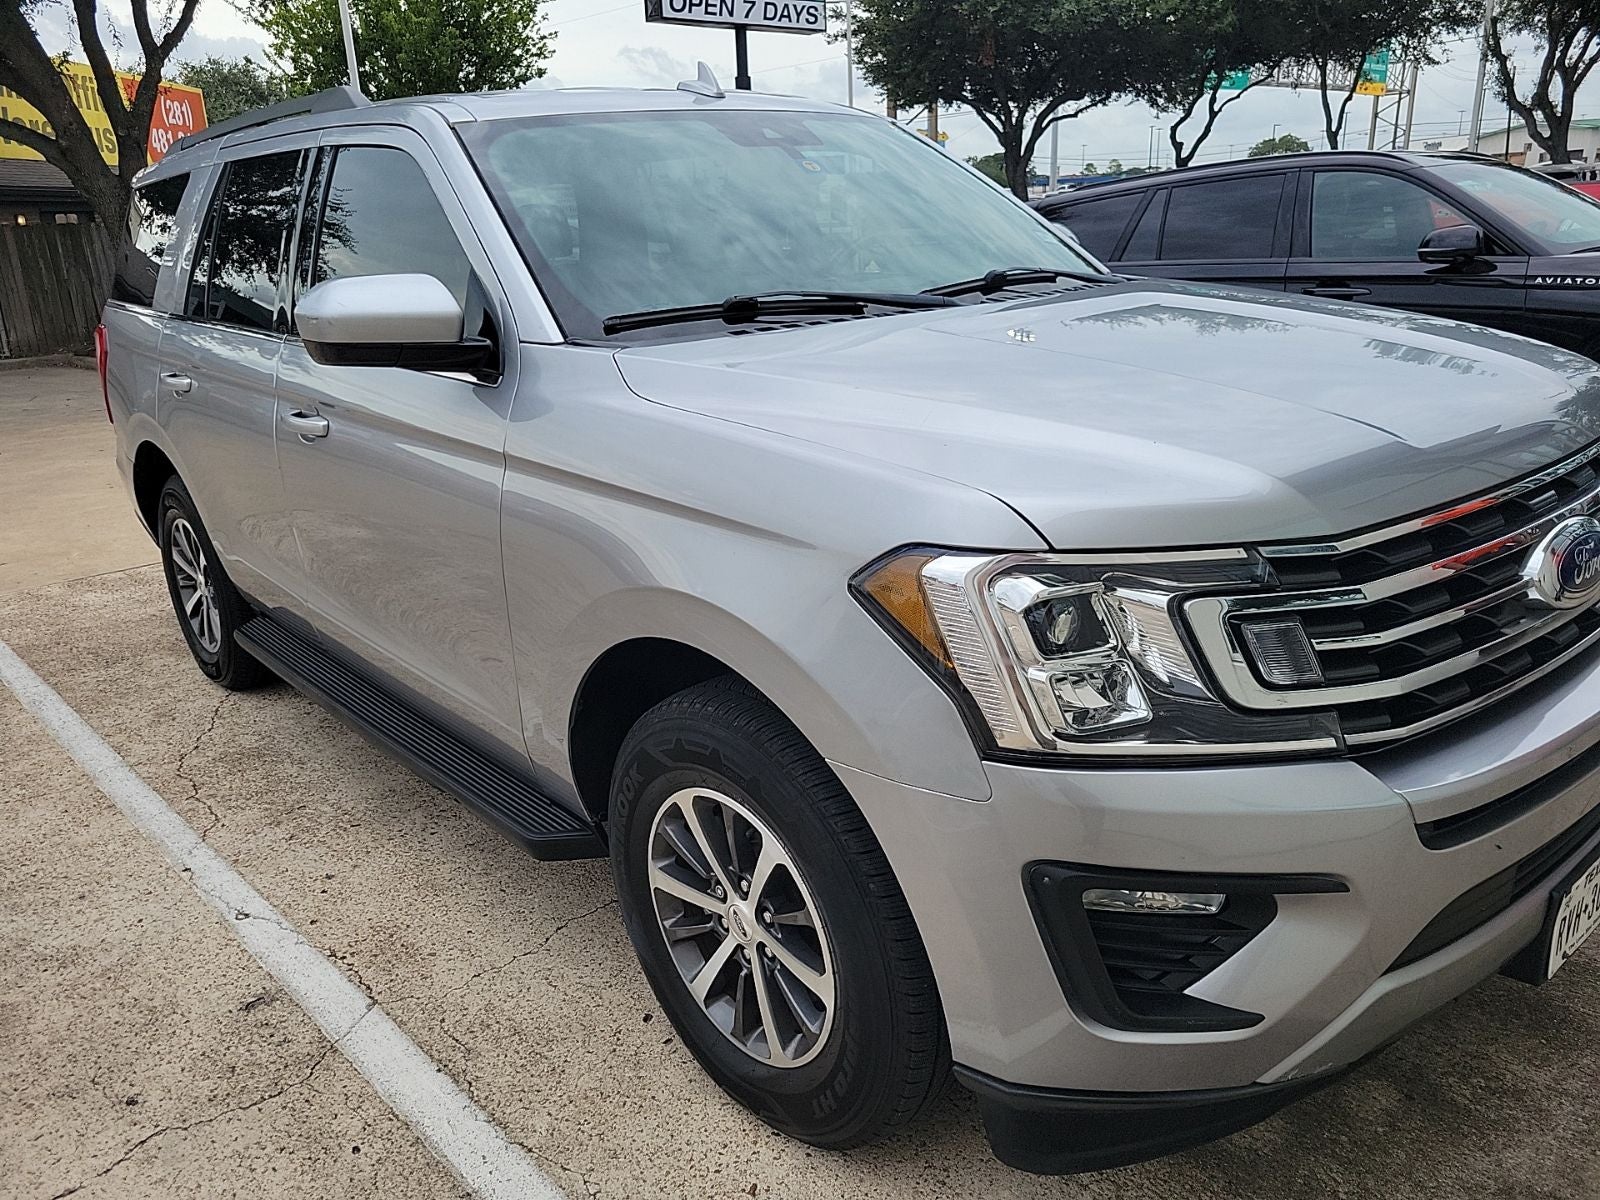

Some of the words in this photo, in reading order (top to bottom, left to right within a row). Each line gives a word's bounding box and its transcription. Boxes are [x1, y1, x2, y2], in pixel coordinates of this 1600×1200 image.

[669, 0, 734, 18] OPEN
[743, 0, 757, 19] 7
[763, 1, 819, 25] DAYS
[160, 95, 193, 131] (281)
[1534, 276, 1600, 285] AVIATO
